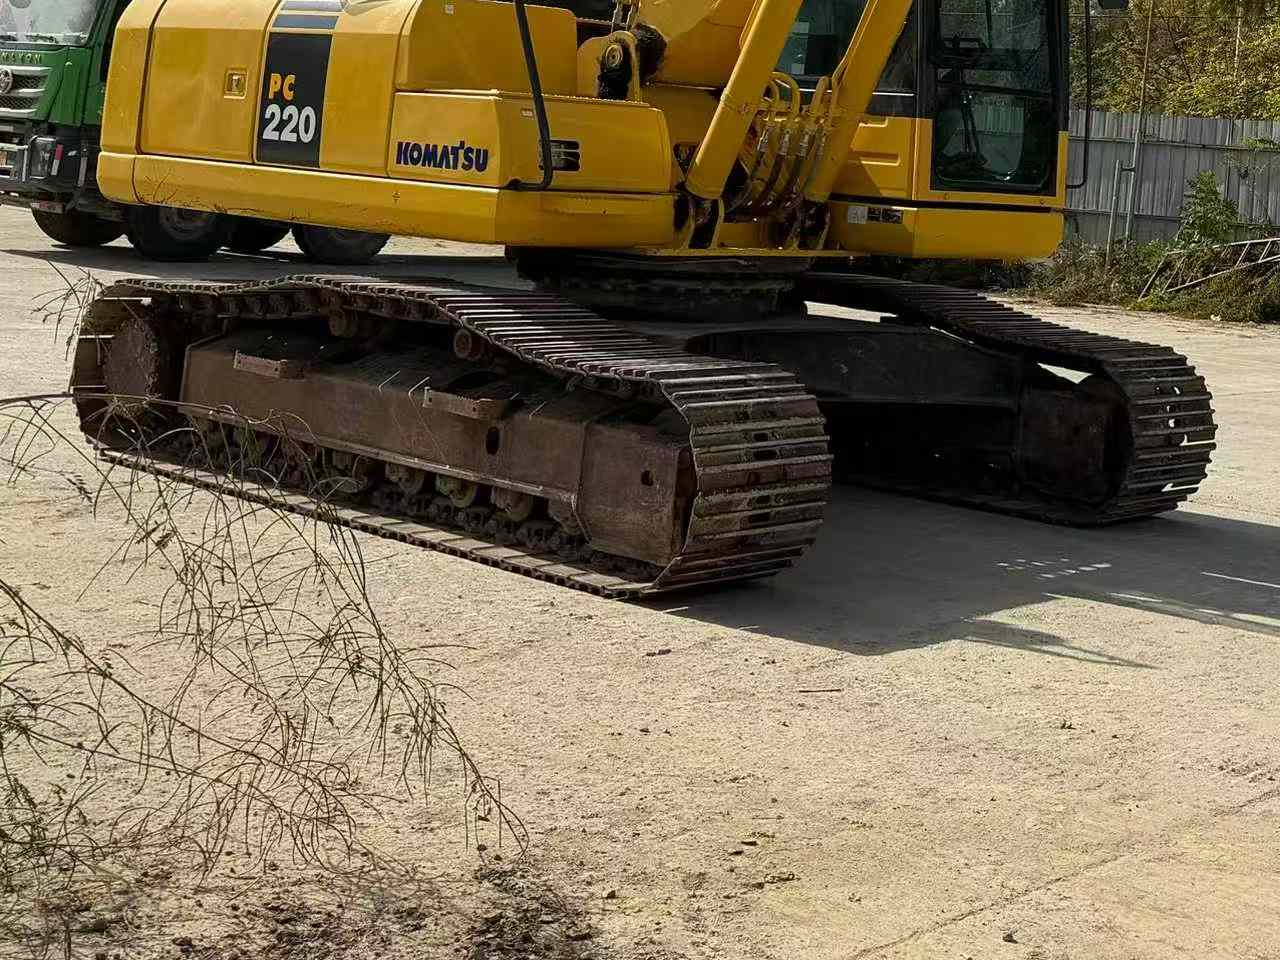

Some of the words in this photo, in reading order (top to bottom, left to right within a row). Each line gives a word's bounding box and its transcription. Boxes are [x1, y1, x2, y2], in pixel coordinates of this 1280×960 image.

[269, 73, 296, 102] PC
[262, 104, 317, 144] 220
[396, 140, 489, 173] KOMATSU
